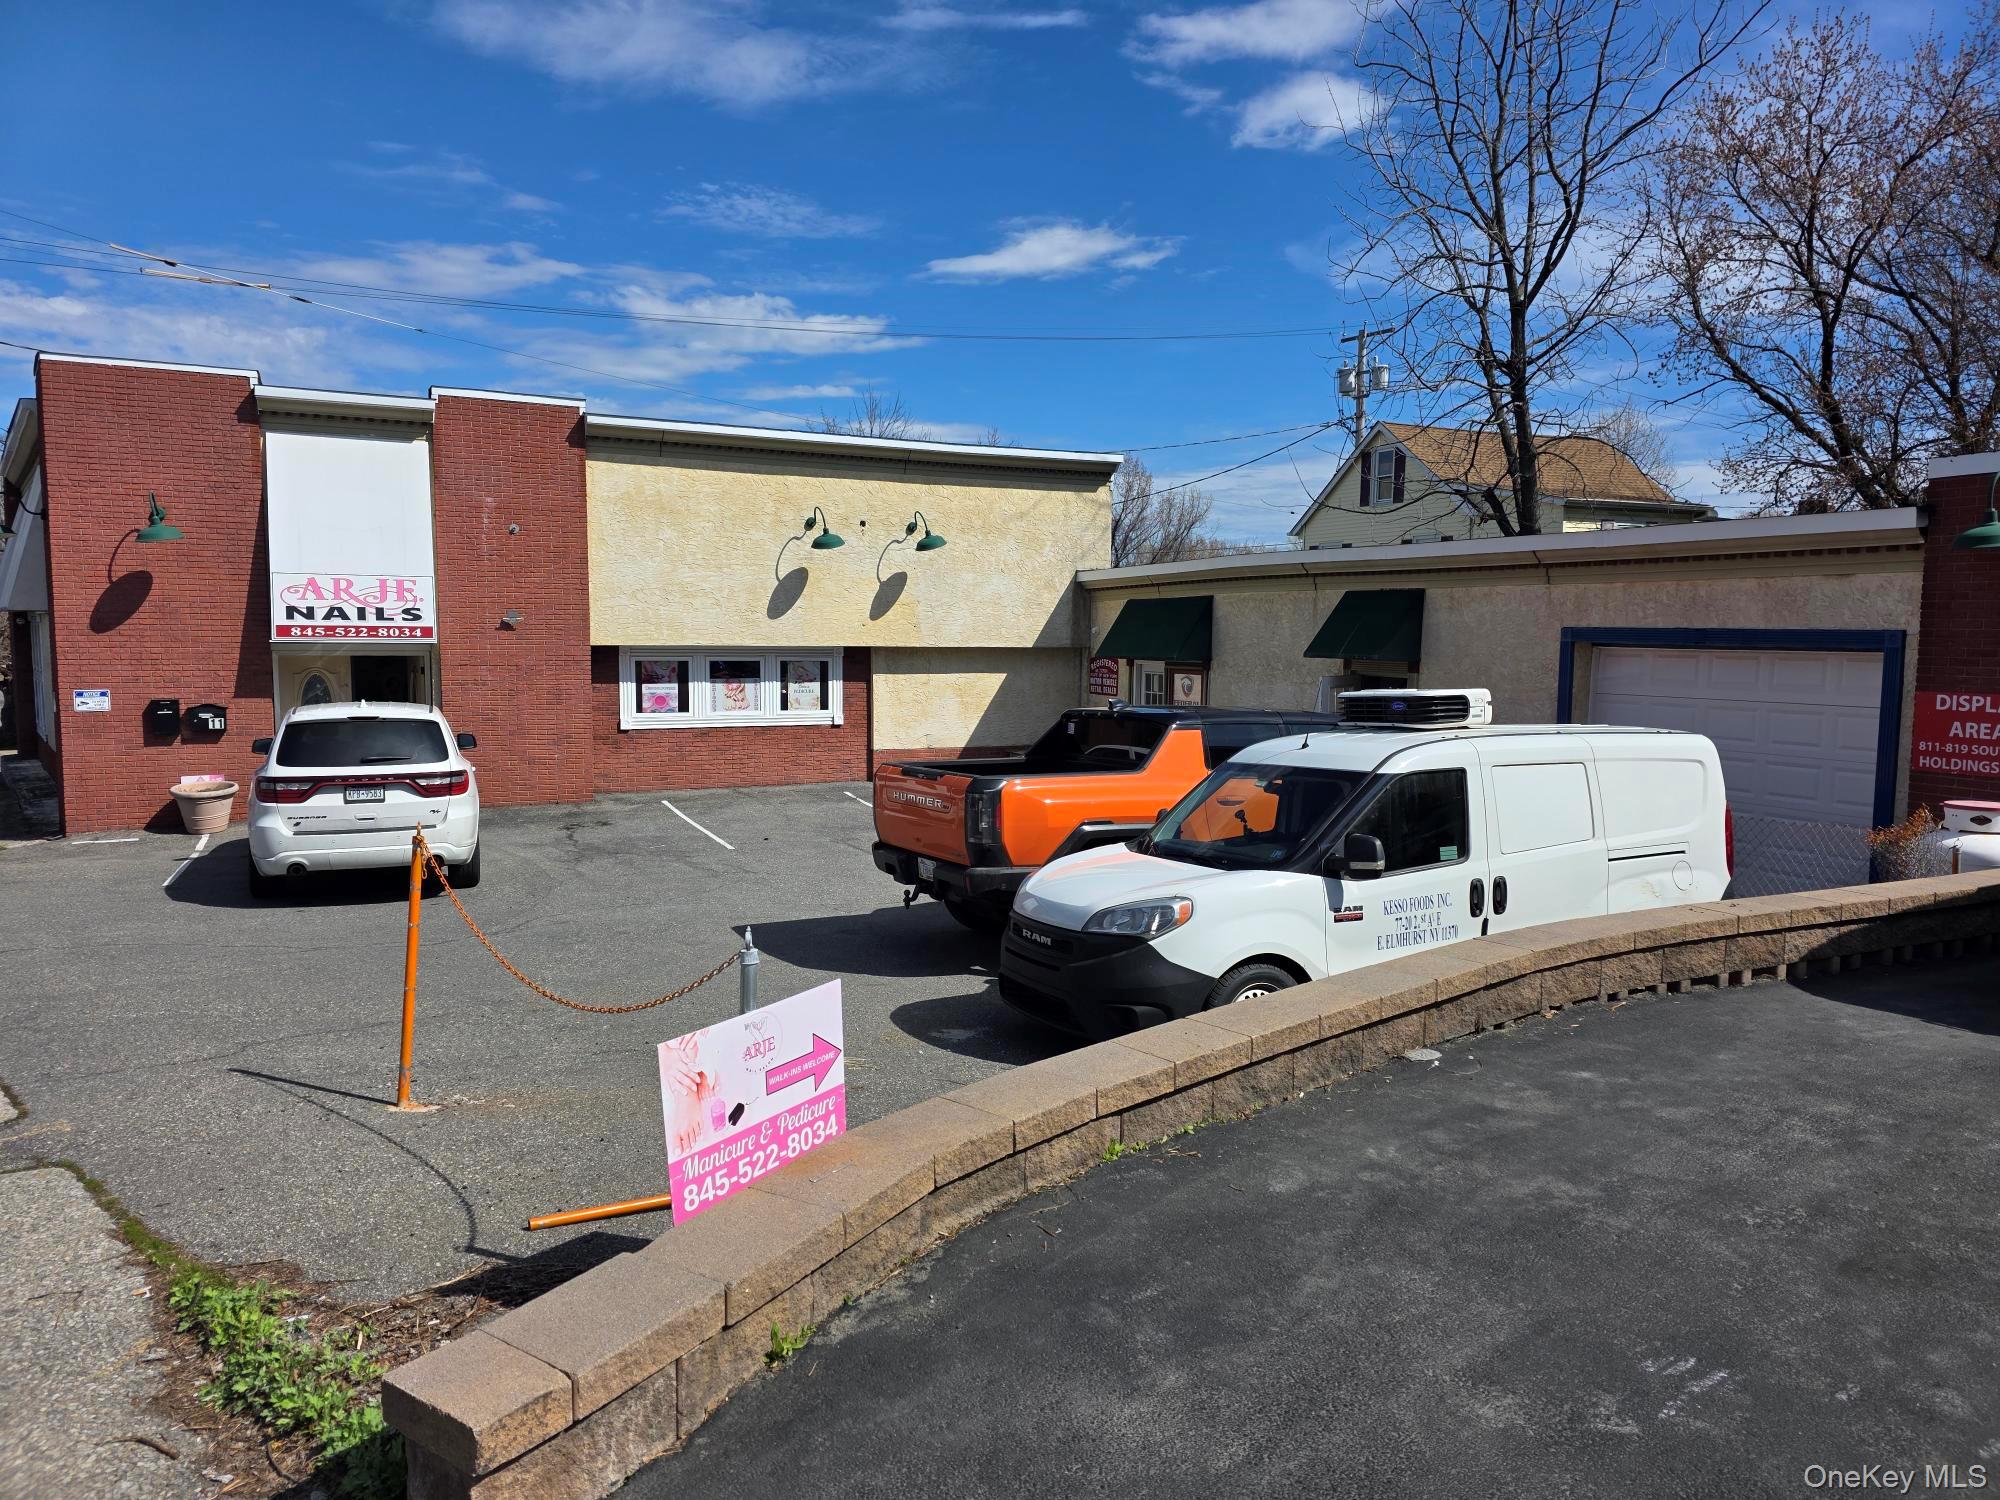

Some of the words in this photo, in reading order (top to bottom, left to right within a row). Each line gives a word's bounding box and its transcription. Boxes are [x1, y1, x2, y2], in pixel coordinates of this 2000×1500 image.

[285, 605, 423, 622] NAILS
[290, 626, 422, 638] 845-522-8034
[1936, 694, 2000, 713] DISPL
[211, 718, 224, 730] 11
[1919, 741, 1968, 754] 811-819
[1971, 744, 2000, 757] SOU
[1920, 755, 2000, 774] HOLDINGS
[893, 791, 942, 808] HUMMER
[1383, 898, 1407, 916] KESSO
[1409, 894, 1434, 912] FOODS
[1437, 892, 1453, 909] INC.
[1022, 928, 1052, 946] RAM
[1386, 929, 1427, 949] ELMHURST
[1429, 926, 1440, 943] NY
[1441, 924, 1459, 941] 11370
[744, 1036, 776, 1061] ARJE
[769, 1065, 802, 1086] WALK-INS
[802, 1050, 835, 1071] WELCOME
[682, 1132, 756, 1182] Manicure
[760, 1121, 773, 1144] &
[777, 1095, 836, 1136] Pedicure
[683, 1113, 838, 1212] 845-522-8034
